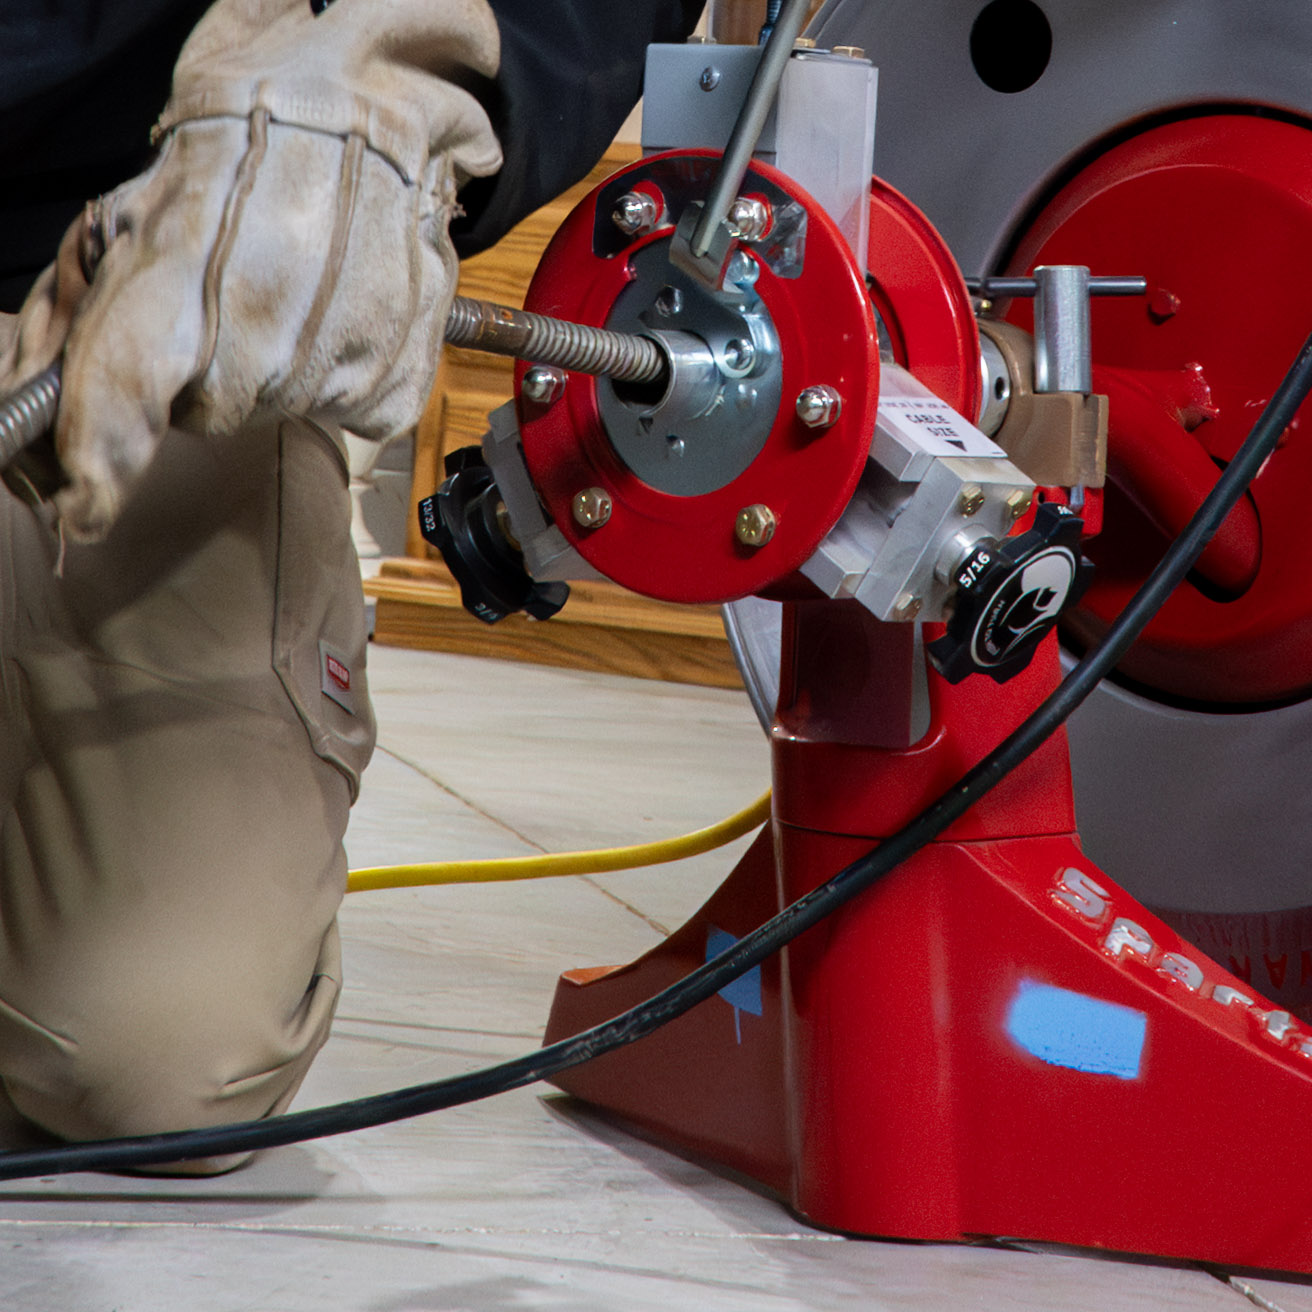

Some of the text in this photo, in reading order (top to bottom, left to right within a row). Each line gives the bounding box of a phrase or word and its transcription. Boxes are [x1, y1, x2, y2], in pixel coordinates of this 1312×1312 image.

[905, 414, 951, 424] CABLE
[422, 498, 436, 532] 13/32
[959, 552, 990, 588] 5/16
